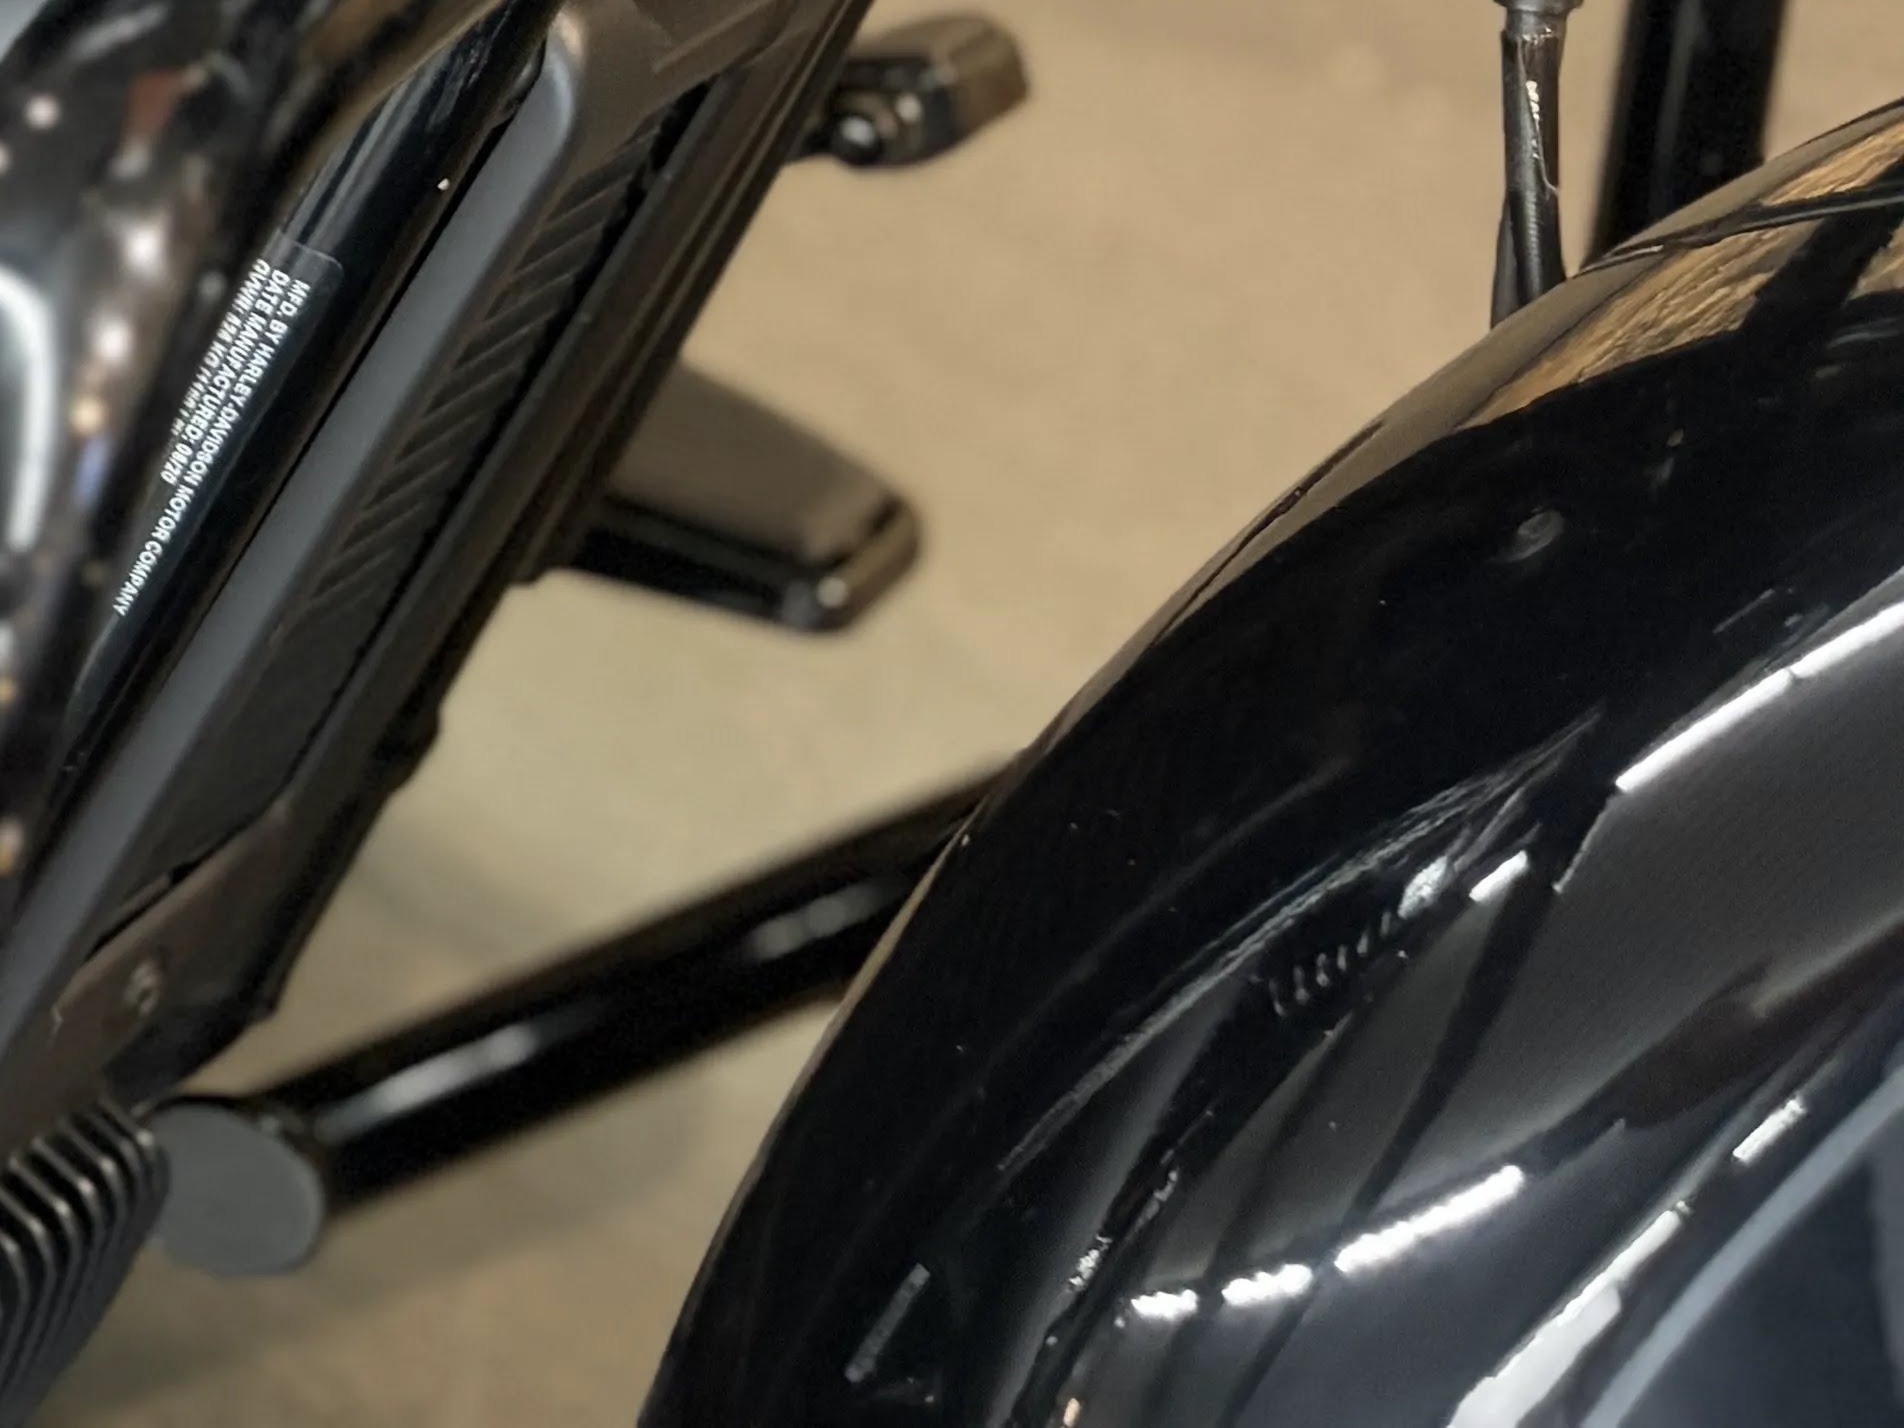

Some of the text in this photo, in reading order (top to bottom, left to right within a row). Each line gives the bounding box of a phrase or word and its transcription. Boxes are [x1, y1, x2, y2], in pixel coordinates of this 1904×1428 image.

[254, 269, 290, 315] DATE
[278, 279, 311, 318] MFD.
[264, 319, 289, 345] BY
[181, 312, 267, 443] MANUFACTURED:
[184, 342, 276, 486] HARLEY-DAVIDSON
[152, 485, 195, 543] MOTOR
[113, 540, 163, 617] COMPANY
